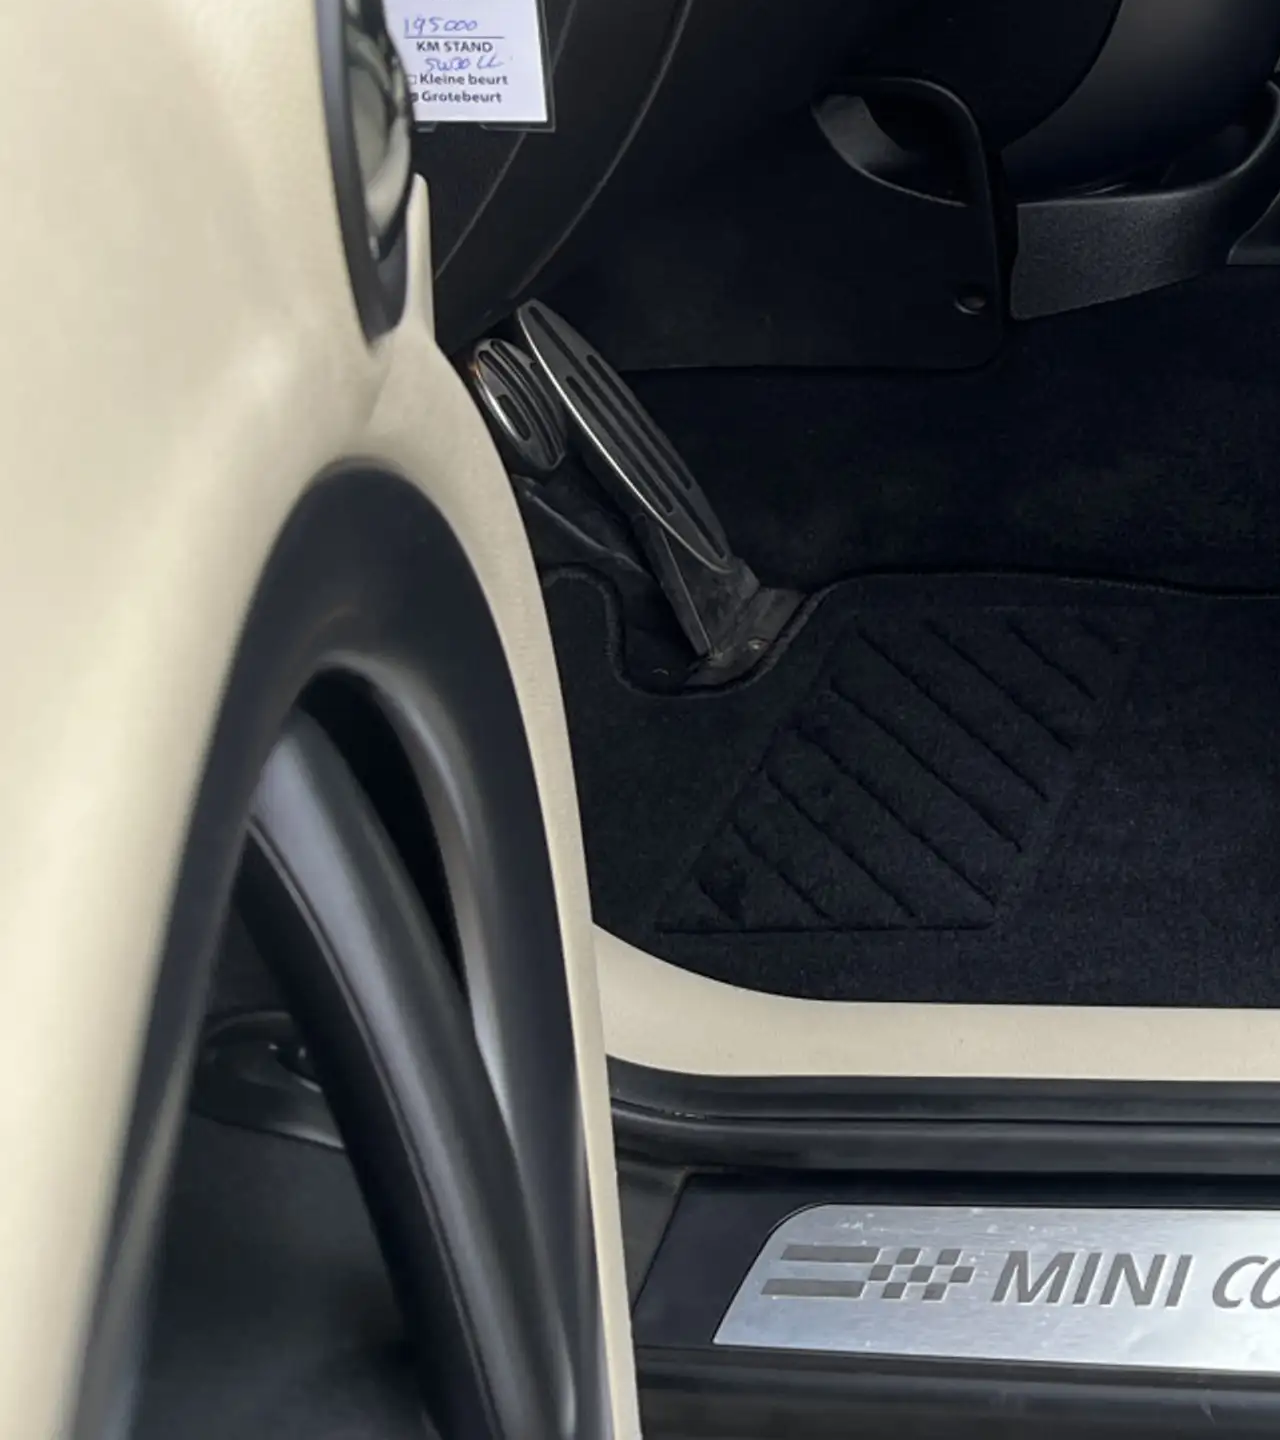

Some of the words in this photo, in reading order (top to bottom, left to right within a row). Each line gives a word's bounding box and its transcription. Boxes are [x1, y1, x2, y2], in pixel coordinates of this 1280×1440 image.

[416, 41, 440, 53] KM
[444, 41, 494, 53] STAND
[420, 73, 465, 85] Kleine
[468, 73, 508, 85] beurt
[422, 90, 502, 103] Grotebeurt
[990, 1250, 1193, 1308] MINI
